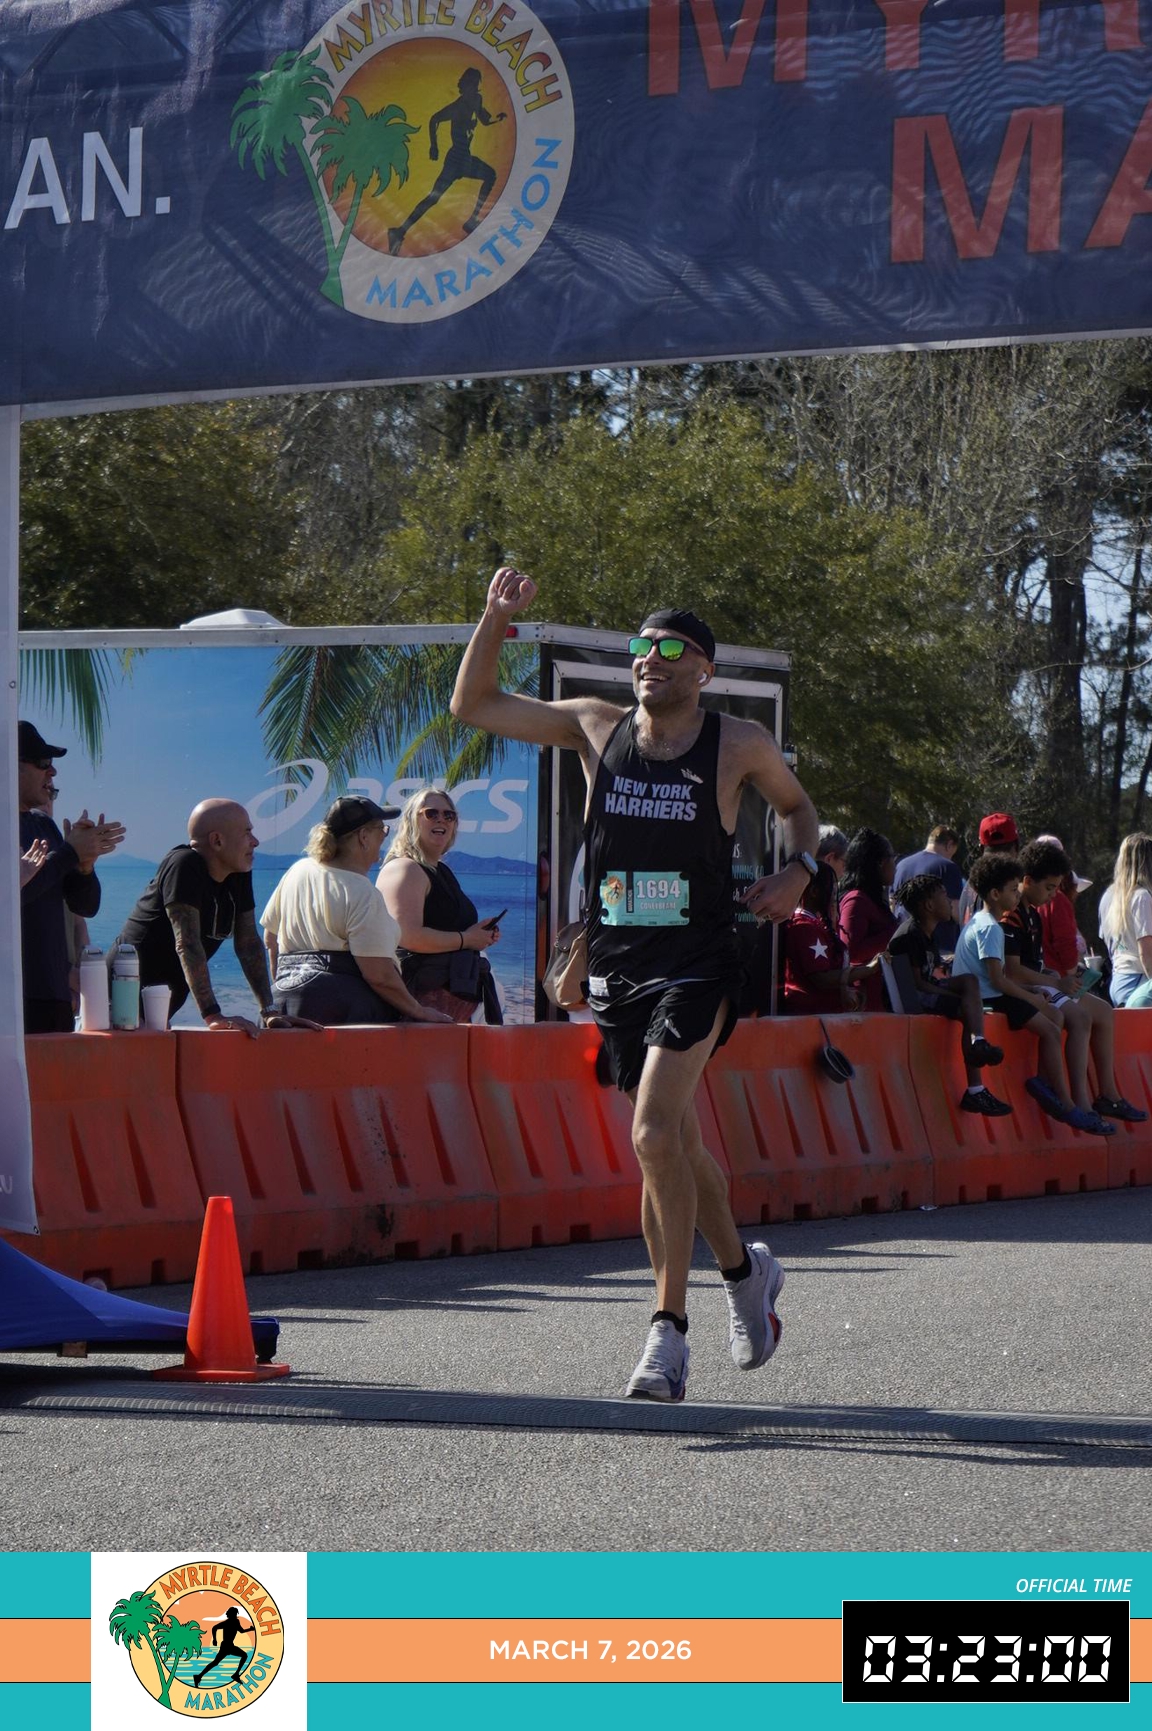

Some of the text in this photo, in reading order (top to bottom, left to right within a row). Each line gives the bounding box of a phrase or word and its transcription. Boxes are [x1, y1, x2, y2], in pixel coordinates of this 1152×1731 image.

[464, 0, 563, 113] BEACH
[365, 137, 563, 309] MARATHON
[346, 777, 529, 834] SCS
[605, 793, 697, 822] HARRIERS
[613, 775, 693, 800] NEW YORK
[636, 880, 681, 899] 1694
